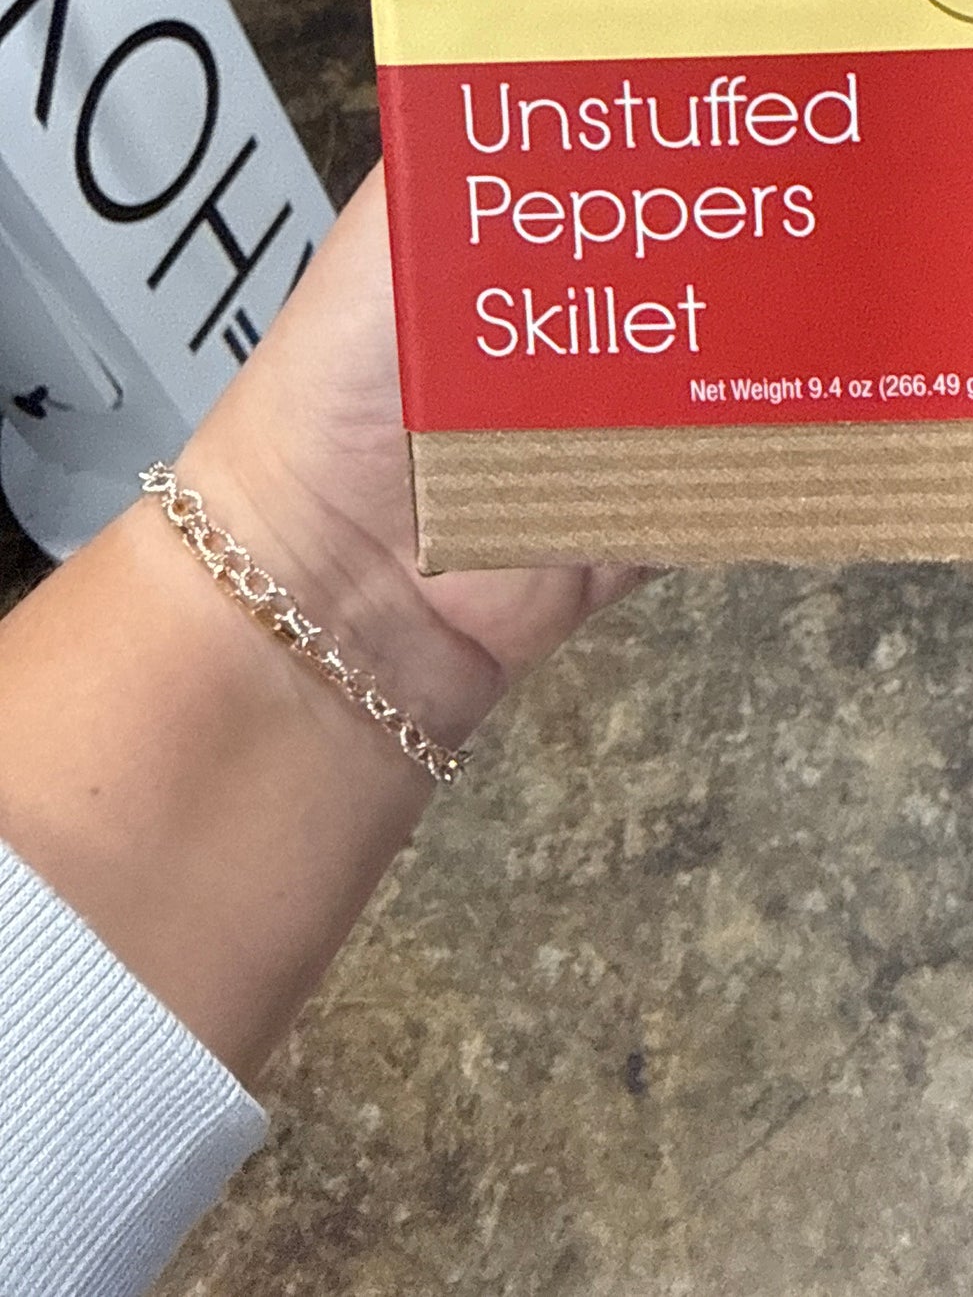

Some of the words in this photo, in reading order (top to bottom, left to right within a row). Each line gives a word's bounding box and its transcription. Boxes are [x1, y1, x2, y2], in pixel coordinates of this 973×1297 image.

[460, 71, 861, 154] Unstuffed
[465, 174, 817, 261] Peppers
[475, 283, 707, 358] Skillet
[689, 378, 727, 403] Net
[730, 376, 803, 405] Weight
[807, 375, 843, 399] 9.4
[848, 378, 874, 399] oz
[878, 372, 961, 402] (266.49
